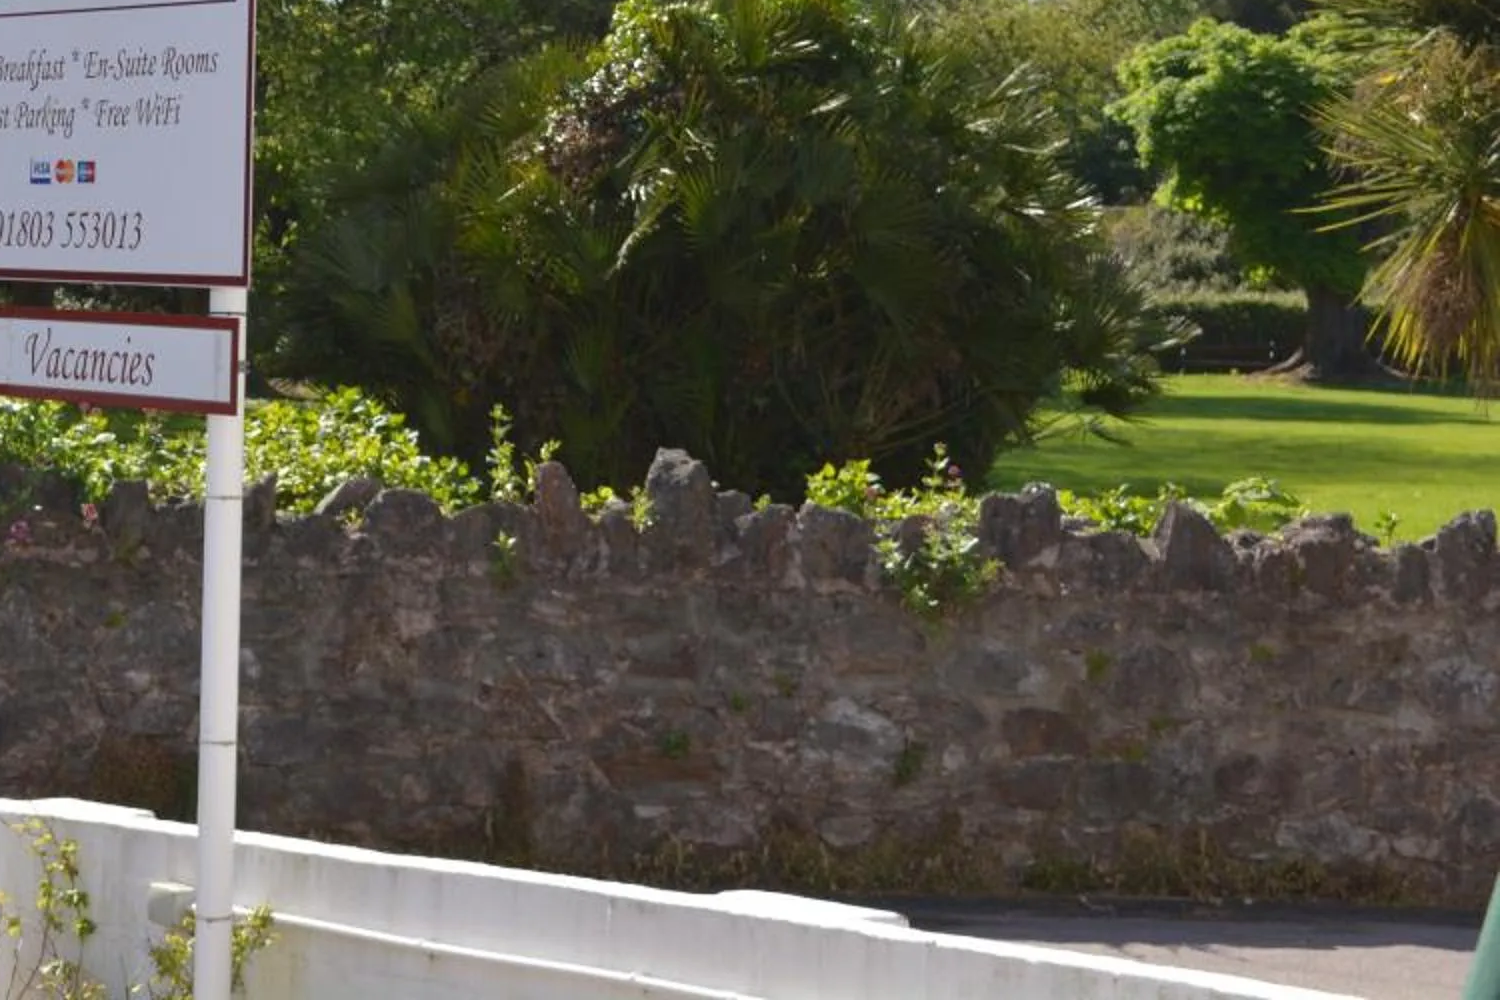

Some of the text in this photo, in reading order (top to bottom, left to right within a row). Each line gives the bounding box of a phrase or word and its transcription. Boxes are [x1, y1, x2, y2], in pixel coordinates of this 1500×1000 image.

[84, 46, 156, 80] En-Suite
[161, 46, 219, 80] Rooms
[15, 95, 76, 139] Parking
[95, 99, 130, 128] Free
[59, 211, 145, 249] 553013
[25, 328, 155, 386] Vacancies
